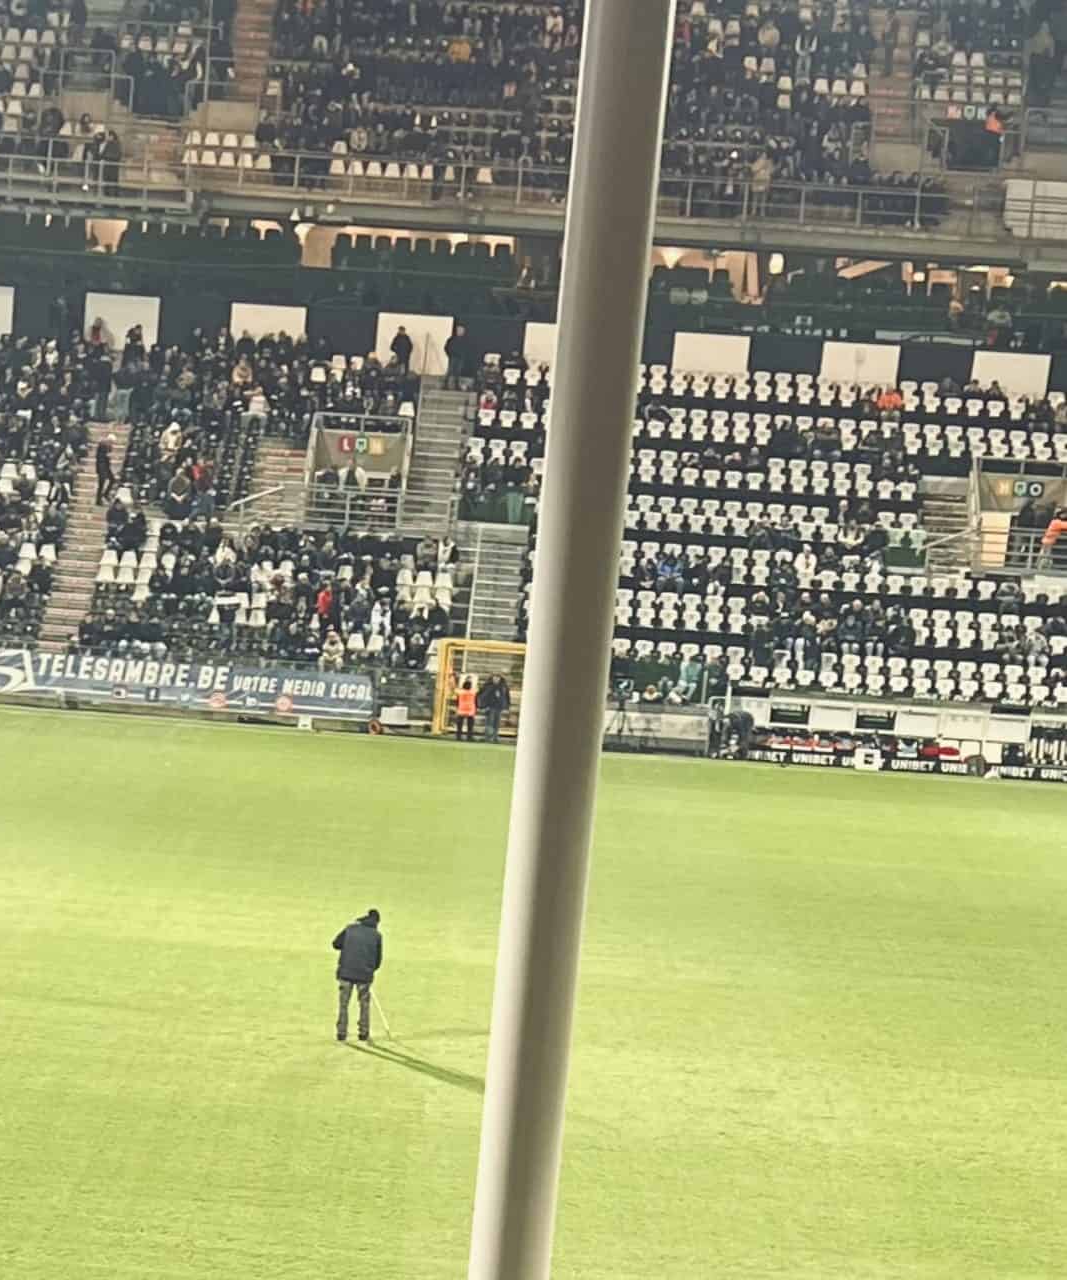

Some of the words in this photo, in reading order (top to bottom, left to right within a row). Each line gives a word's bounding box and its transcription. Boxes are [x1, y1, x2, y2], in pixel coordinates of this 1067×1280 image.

[233, 675, 278, 693] VOTRE
[330, 682, 373, 700] LOCAL
[792, 751, 835, 765] UNIBET
[891, 759, 935, 772] UNIBET
